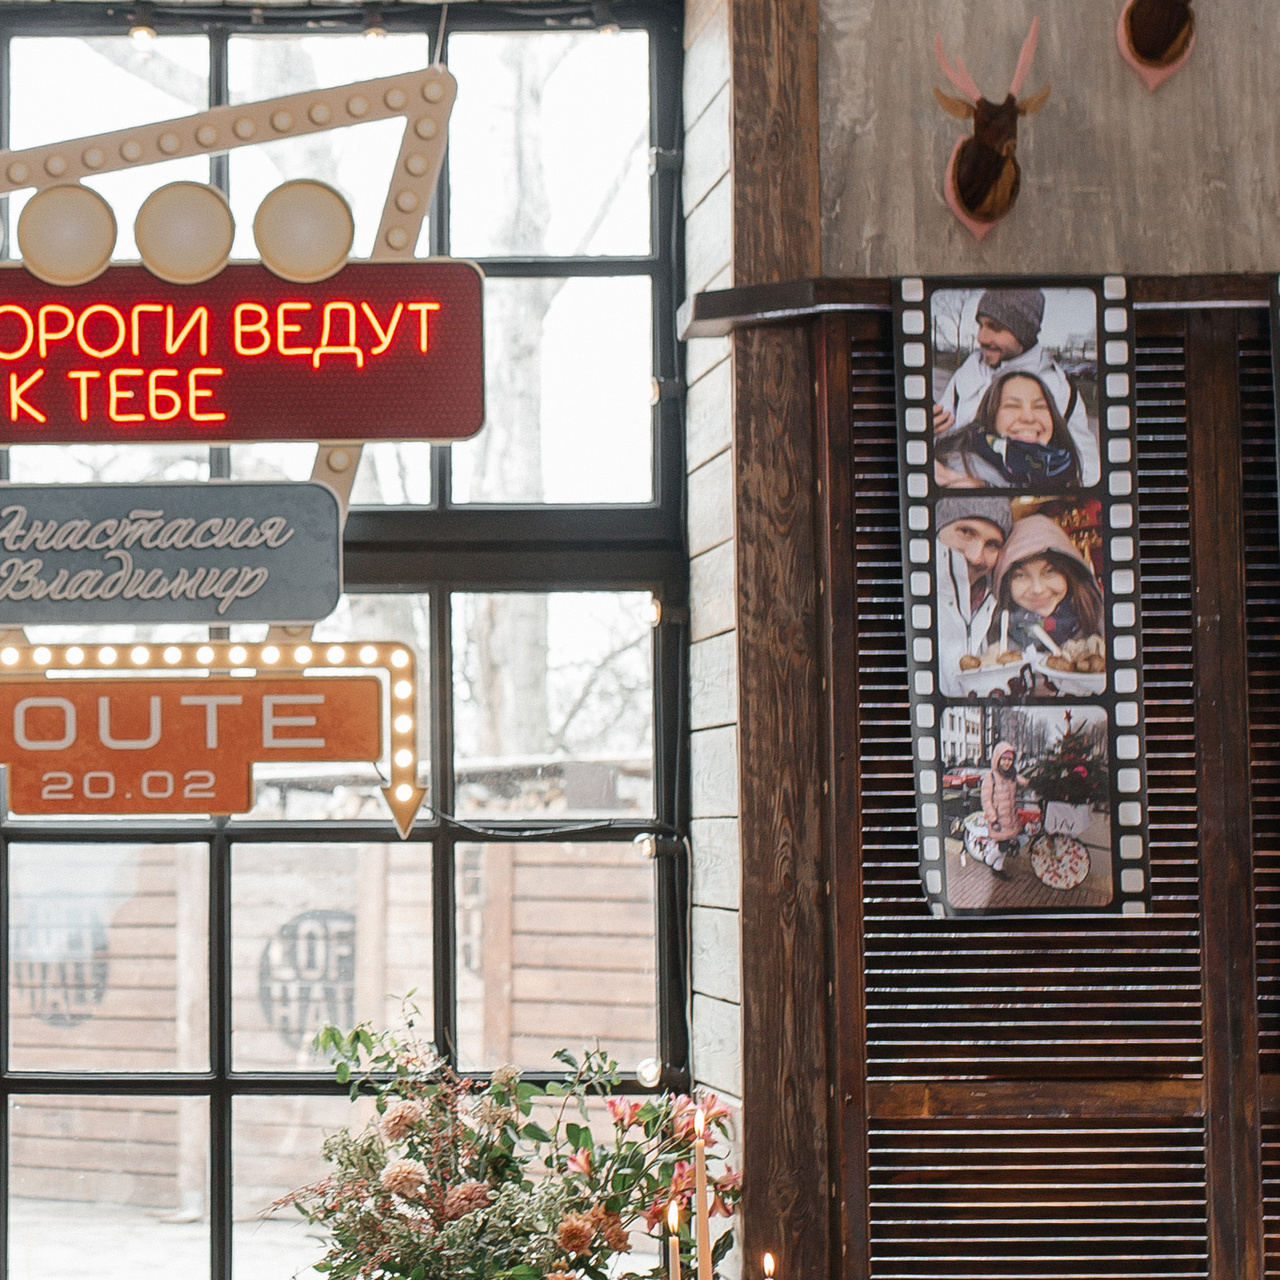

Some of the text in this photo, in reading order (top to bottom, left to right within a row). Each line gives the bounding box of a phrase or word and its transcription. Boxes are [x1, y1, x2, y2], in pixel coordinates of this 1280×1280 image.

[233, 301, 441, 369] ВЕДУТ
[9, 368, 227, 423] К ТЕБЕ
[40, 770, 217, 800] 20.02
